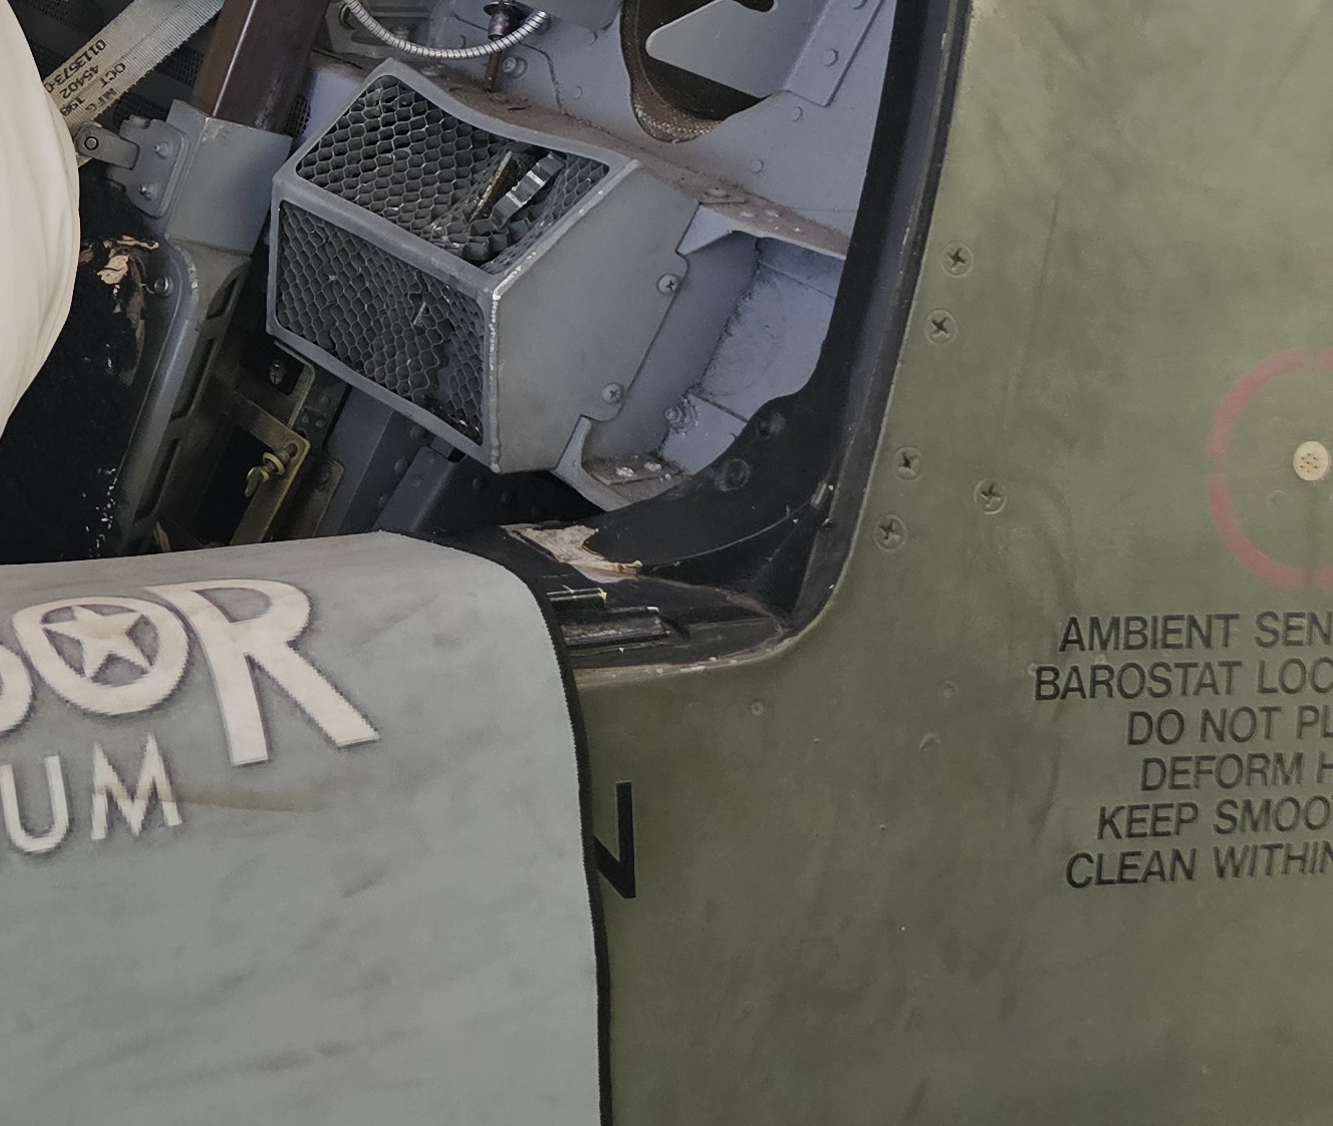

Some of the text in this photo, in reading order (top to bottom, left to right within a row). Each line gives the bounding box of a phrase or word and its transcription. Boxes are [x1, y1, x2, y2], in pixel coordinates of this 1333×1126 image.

[59, 65, 99, 99] 45402
[99, 62, 126, 88] OCT
[85, 87, 117, 112] MFG
[1058, 610, 1333, 652] AMBIENT SEN
[1034, 656, 1333, 702] BAROSTAT LOC
[1126, 708, 1185, 746] DO
[1199, 706, 1282, 744] NOT
[1140, 752, 1305, 791] DEFORM
[1097, 795, 1333, 841] KEEP SMOO
[1066, 846, 1197, 889] CLEAN
